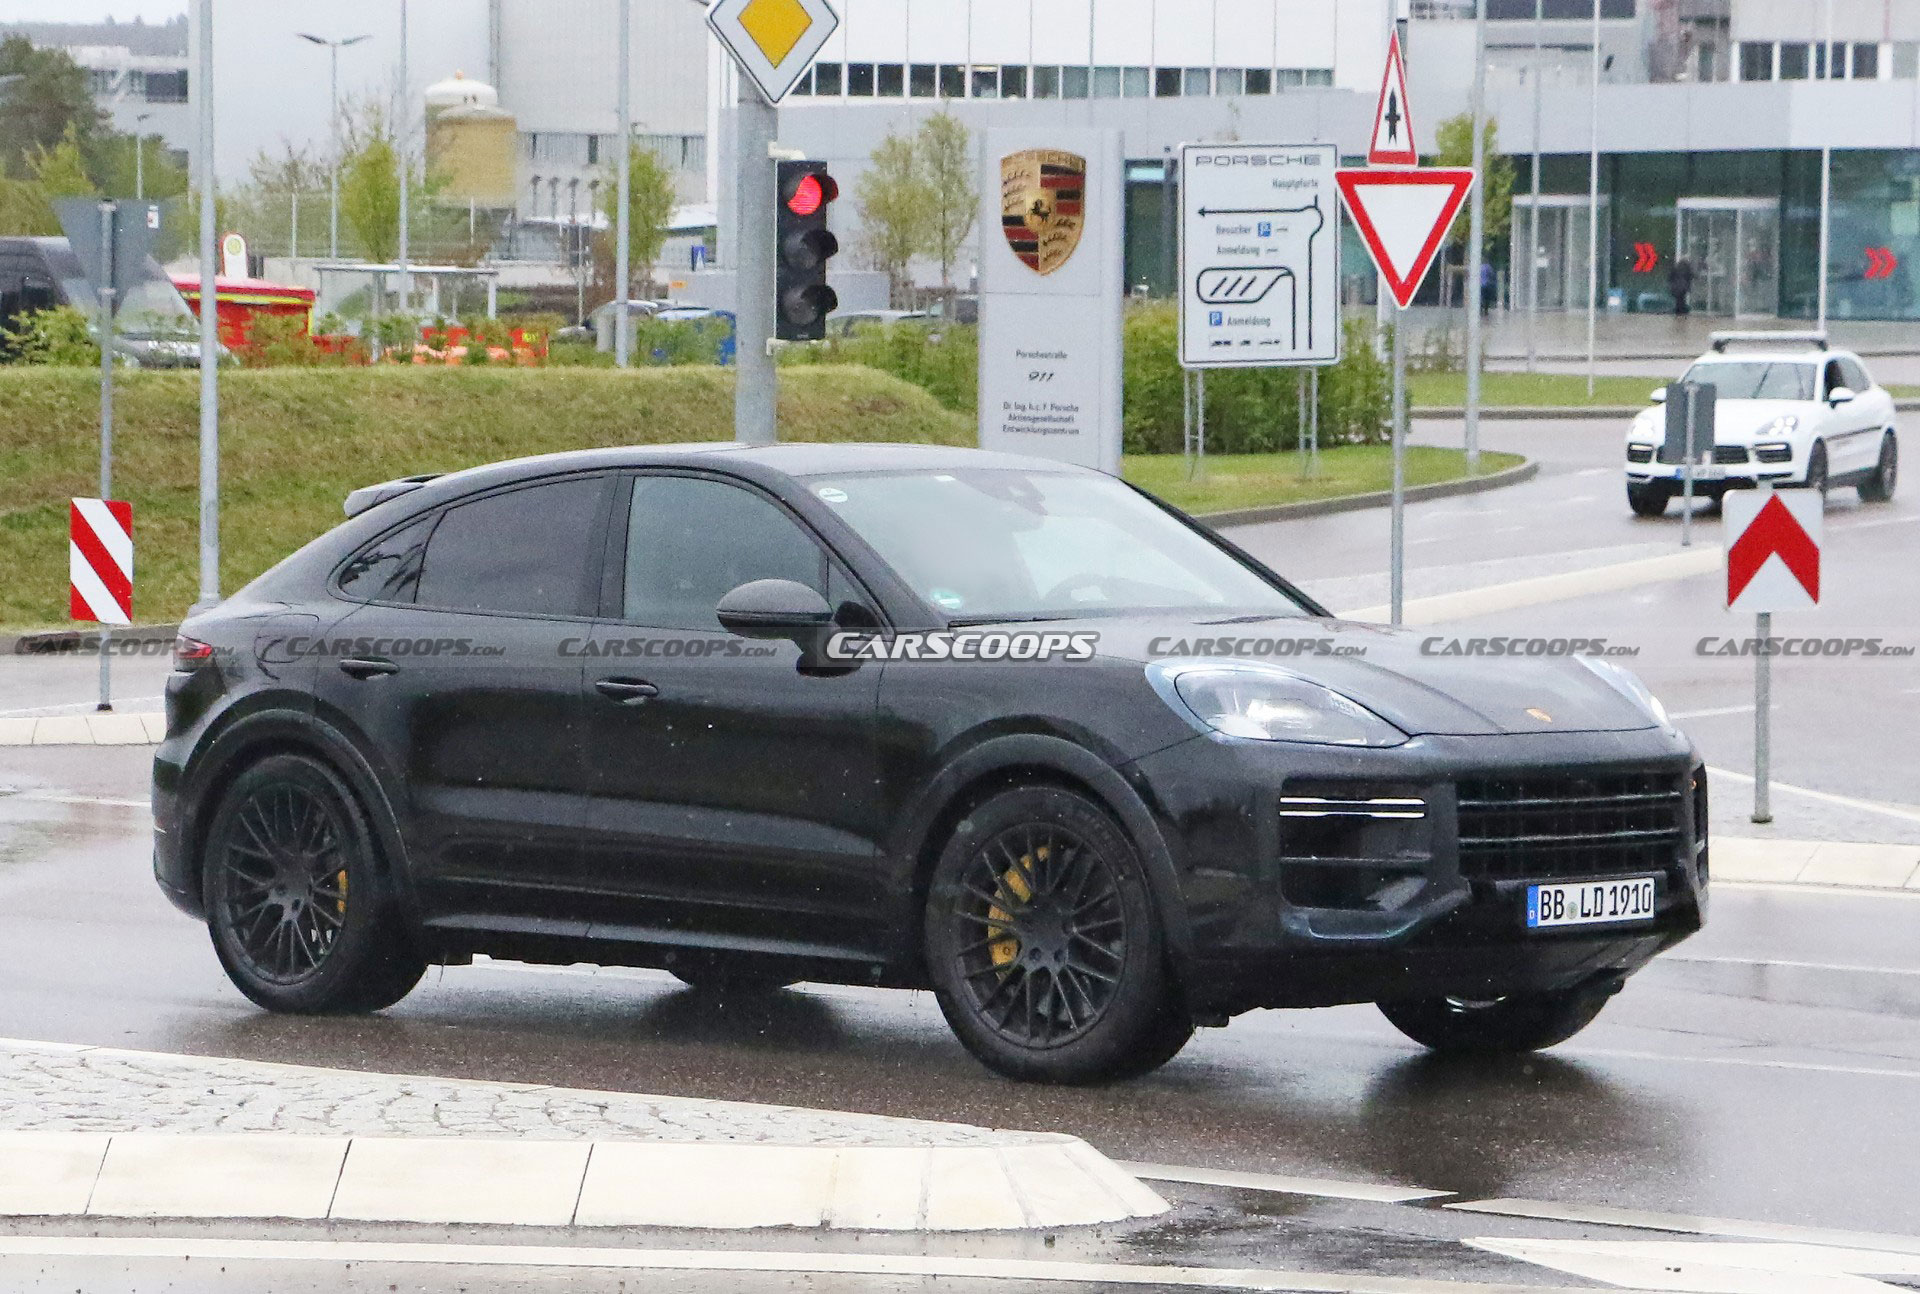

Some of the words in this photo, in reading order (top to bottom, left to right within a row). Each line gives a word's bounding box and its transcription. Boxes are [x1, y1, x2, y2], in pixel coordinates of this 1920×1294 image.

[1196, 154, 1321, 166] PORSCHE
[1227, 316, 1271, 327] Anmeldung
[1029, 371, 1054, 381] 911
[1541, 889, 1565, 920] BB
[1581, 886, 1604, 917] LD
[1609, 883, 1652, 915] 1910
